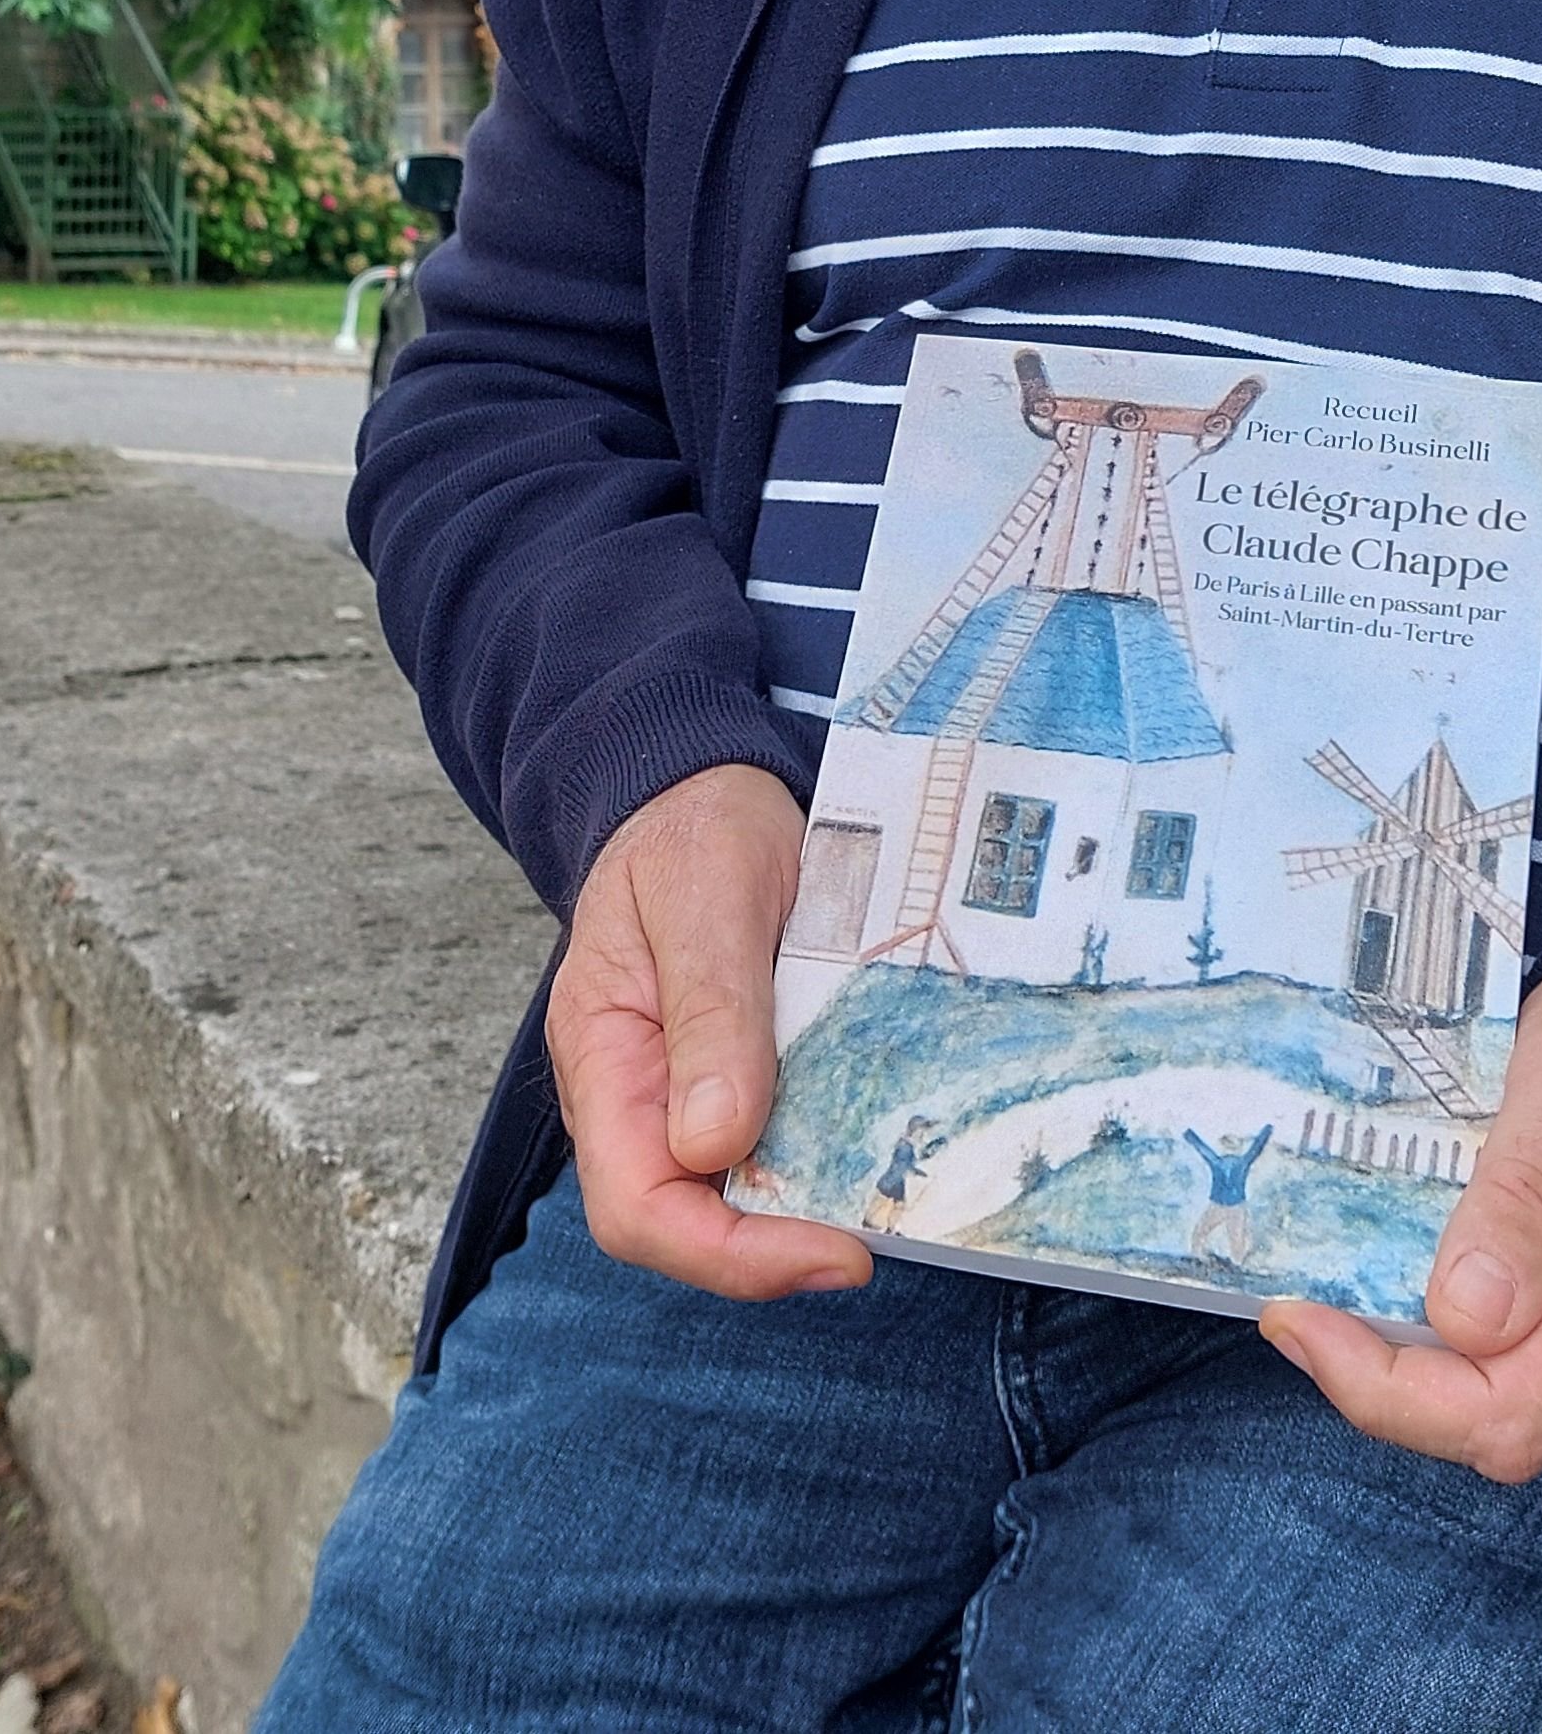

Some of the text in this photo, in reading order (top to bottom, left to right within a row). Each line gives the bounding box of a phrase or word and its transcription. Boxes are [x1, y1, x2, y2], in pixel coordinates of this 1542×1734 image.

[1323, 396, 1418, 424] Recueil
[1245, 420, 1491, 463] Pier Carlo Businelli
[1195, 471, 1528, 533] Le télégraphe de
[1202, 522, 1510, 591] Claude Chappe
[1194, 572, 1508, 626] De Paris à Lille en passant par
[1217, 602, 1476, 648] Saint-Martin-du-Tertre
